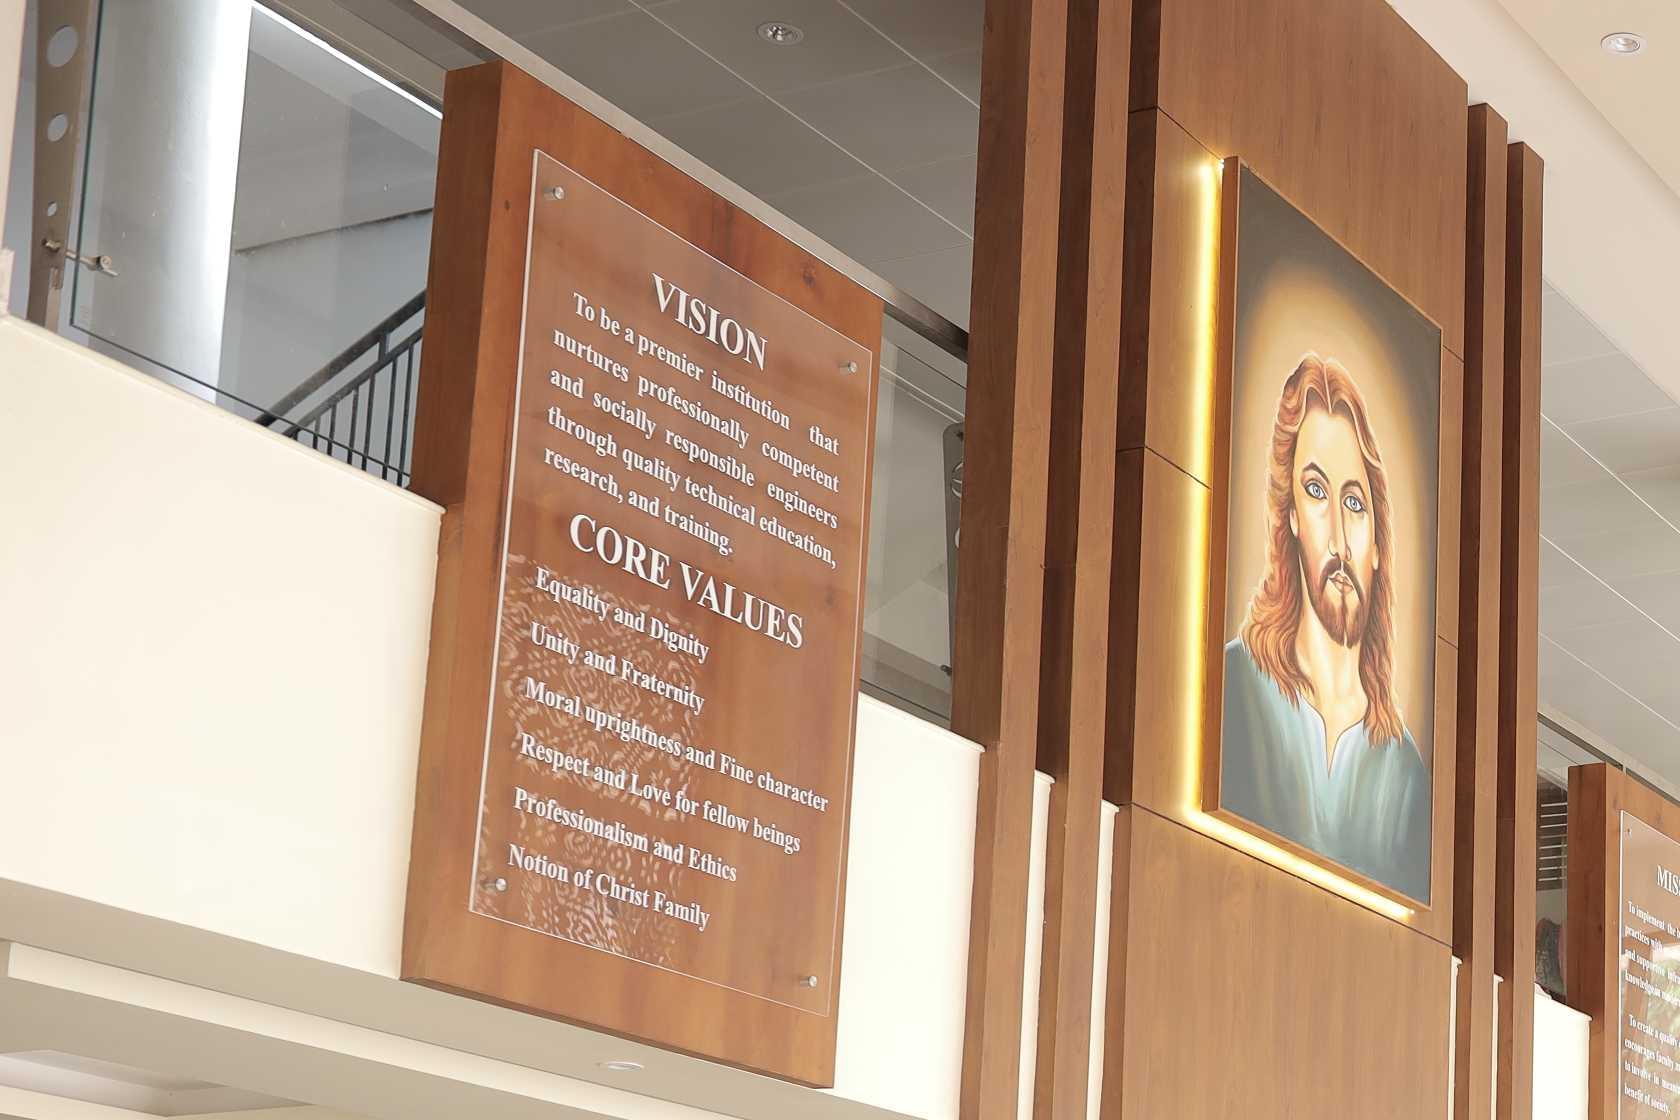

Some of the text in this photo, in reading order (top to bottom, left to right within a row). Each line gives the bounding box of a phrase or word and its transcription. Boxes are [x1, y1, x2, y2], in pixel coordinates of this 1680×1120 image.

[653, 273, 767, 370] VISION
[554, 330, 838, 492] nurtures professionally competent
[574, 293, 838, 455] To be a premier institution that
[549, 407, 835, 569] through quality technical education,
[551, 371, 837, 528] and socially responsible engineers
[545, 448, 732, 555] research, and training.
[536, 567, 708, 663] Equality and Dignity
[571, 515, 802, 648] CORE VALUES
[532, 622, 704, 715] Unity and Fraternity
[519, 730, 800, 854] Respect and Love for fellow beings
[526, 677, 828, 811] Moral uprightness and Fine character
[515, 787, 736, 881] Professionalism and Ethics
[508, 844, 710, 931] Notion of Christ Family
[1624, 922, 1650, 947] practices
[1636, 904, 1664, 932] implement
[1667, 921, 1675, 936] the
[1624, 1038, 1655, 1062] encourages
[1656, 1050, 1673, 1070] faculty
[1637, 1018, 1654, 1036] create
[1659, 1029, 1678, 1050] quality
[1624, 1082, 1643, 1102] benefit
